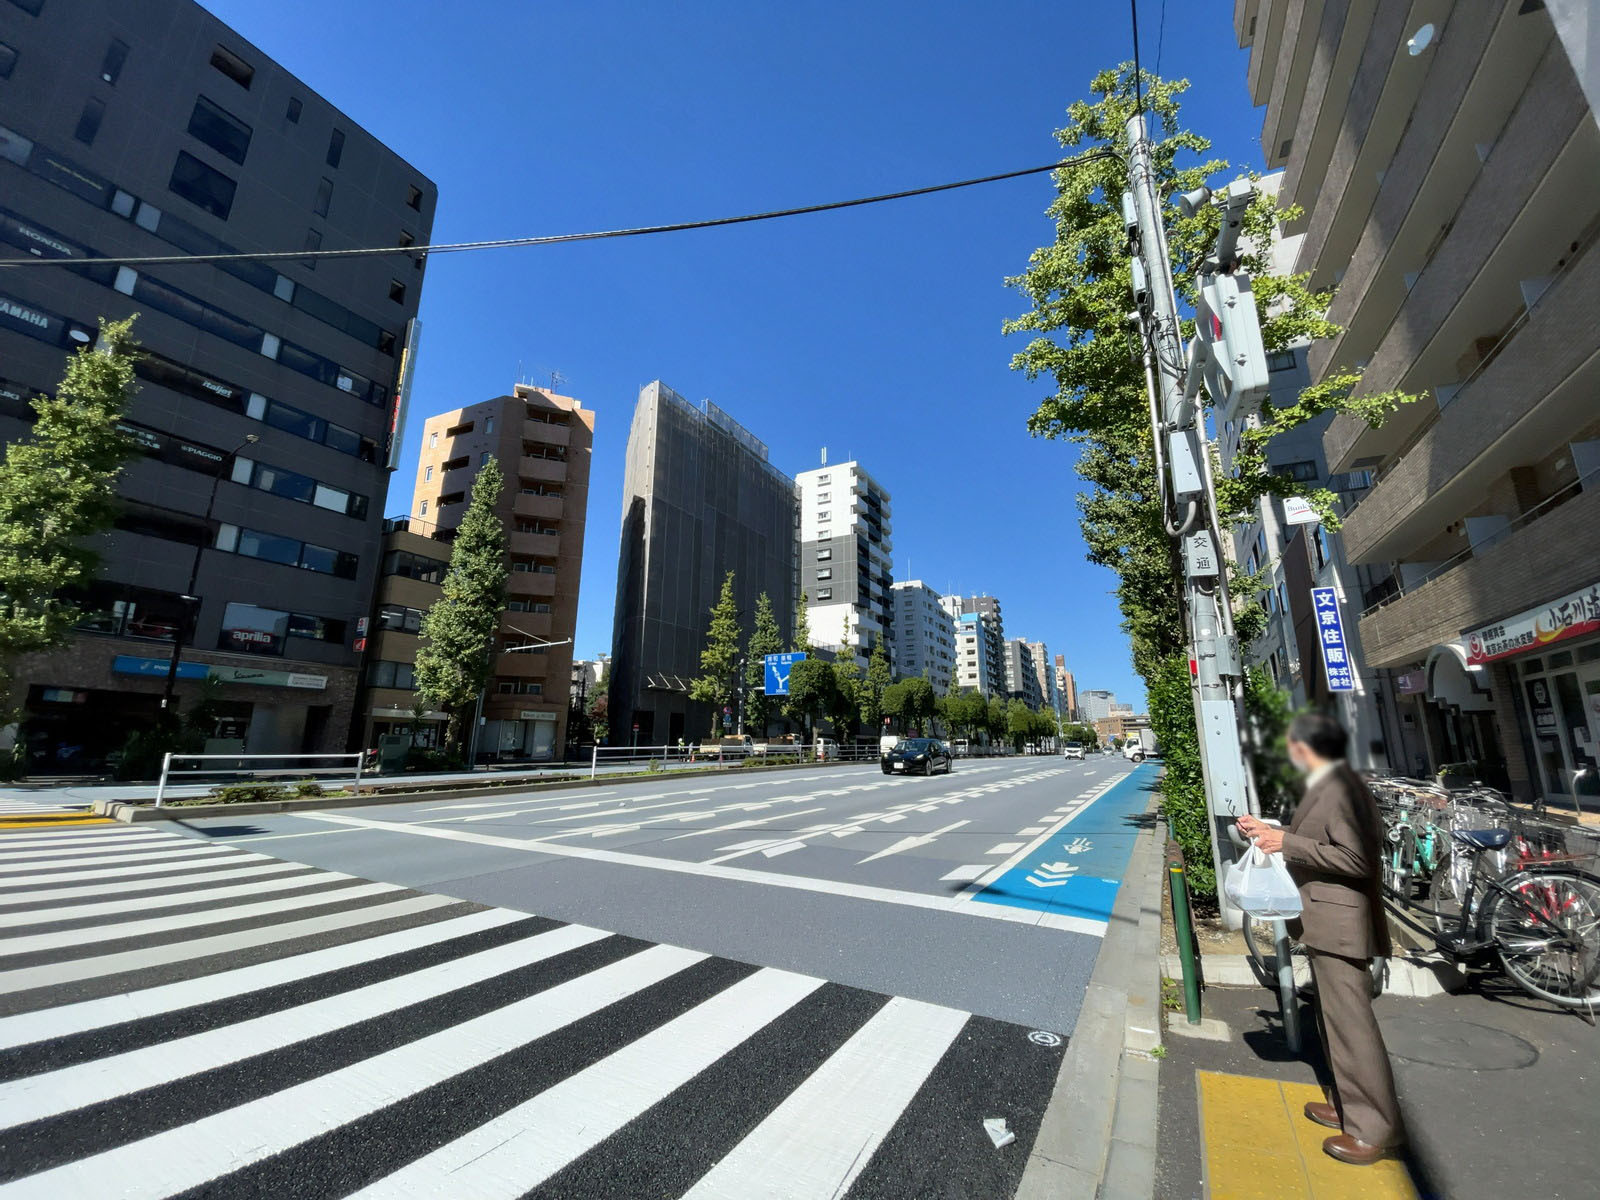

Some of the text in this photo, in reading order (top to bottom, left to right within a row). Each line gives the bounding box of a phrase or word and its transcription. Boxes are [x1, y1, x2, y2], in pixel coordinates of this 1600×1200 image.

[0, 301, 48, 329] AMAHA
[187, 446, 223, 462] PIAGGIO
[1193, 536, 1211, 569] 交通
[232, 631, 271, 643] aprilia
[1315, 591, 1345, 664] 文京住販
